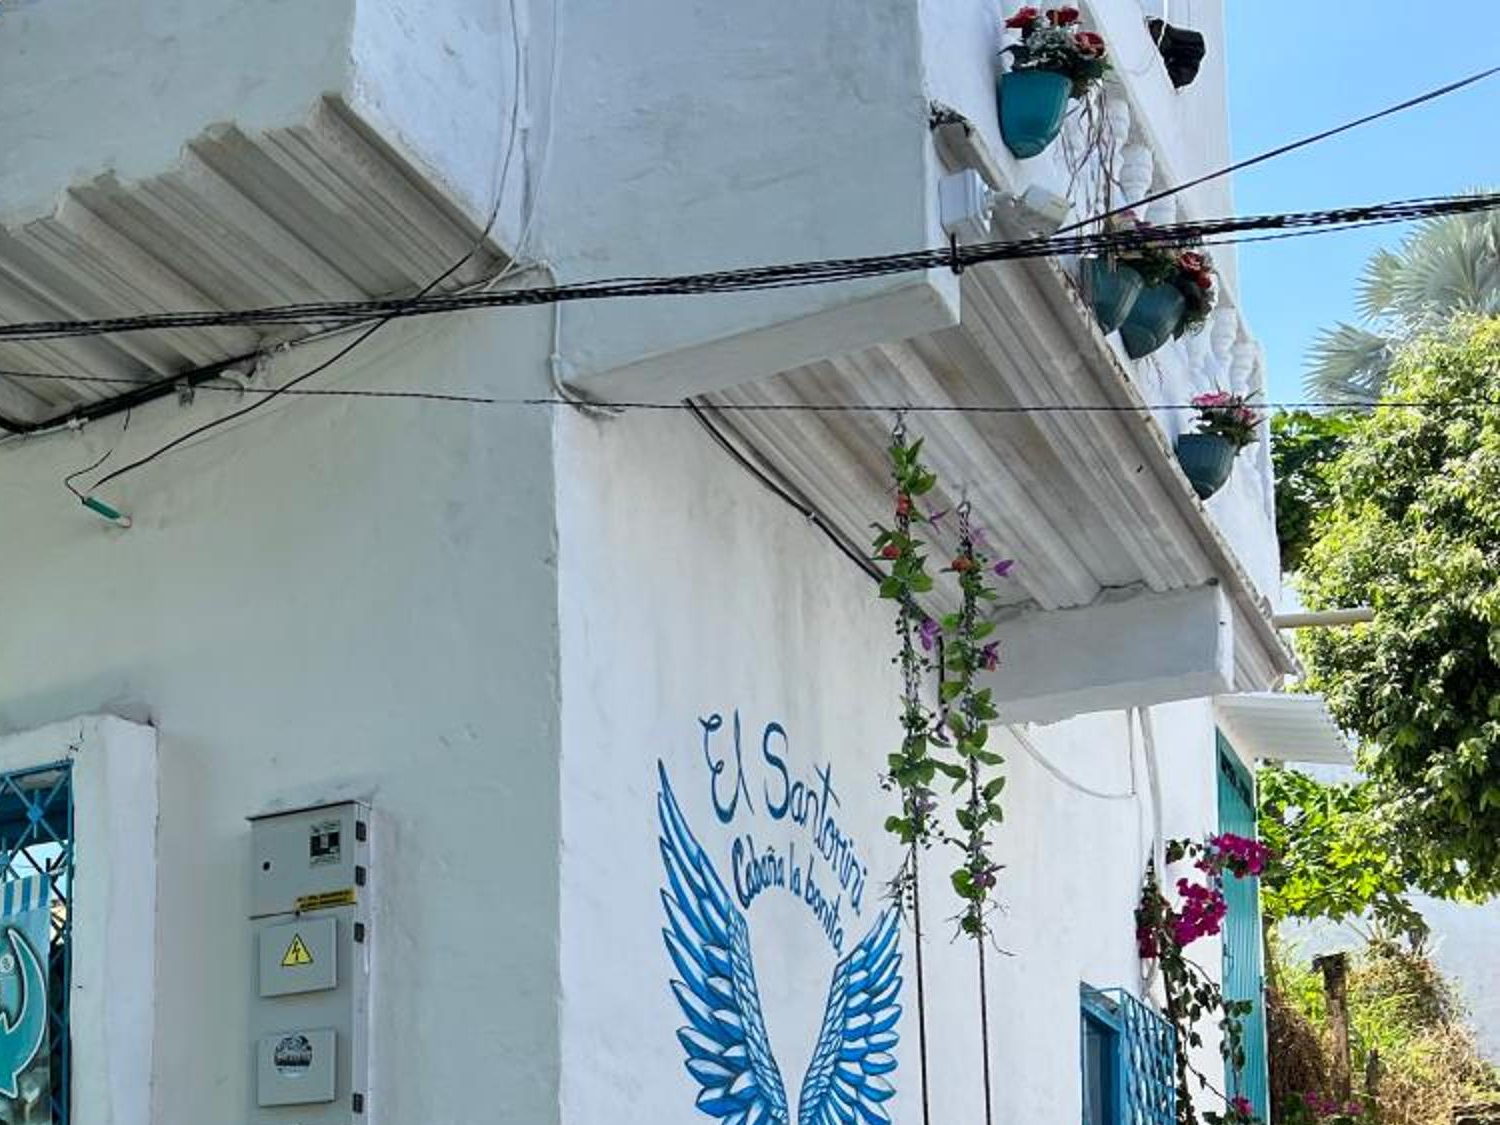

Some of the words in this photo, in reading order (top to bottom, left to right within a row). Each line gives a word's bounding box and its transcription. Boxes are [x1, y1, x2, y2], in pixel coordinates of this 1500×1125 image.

[698, 708, 754, 824] El
[762, 721, 868, 917] Santorini
[789, 841, 801, 896] la
